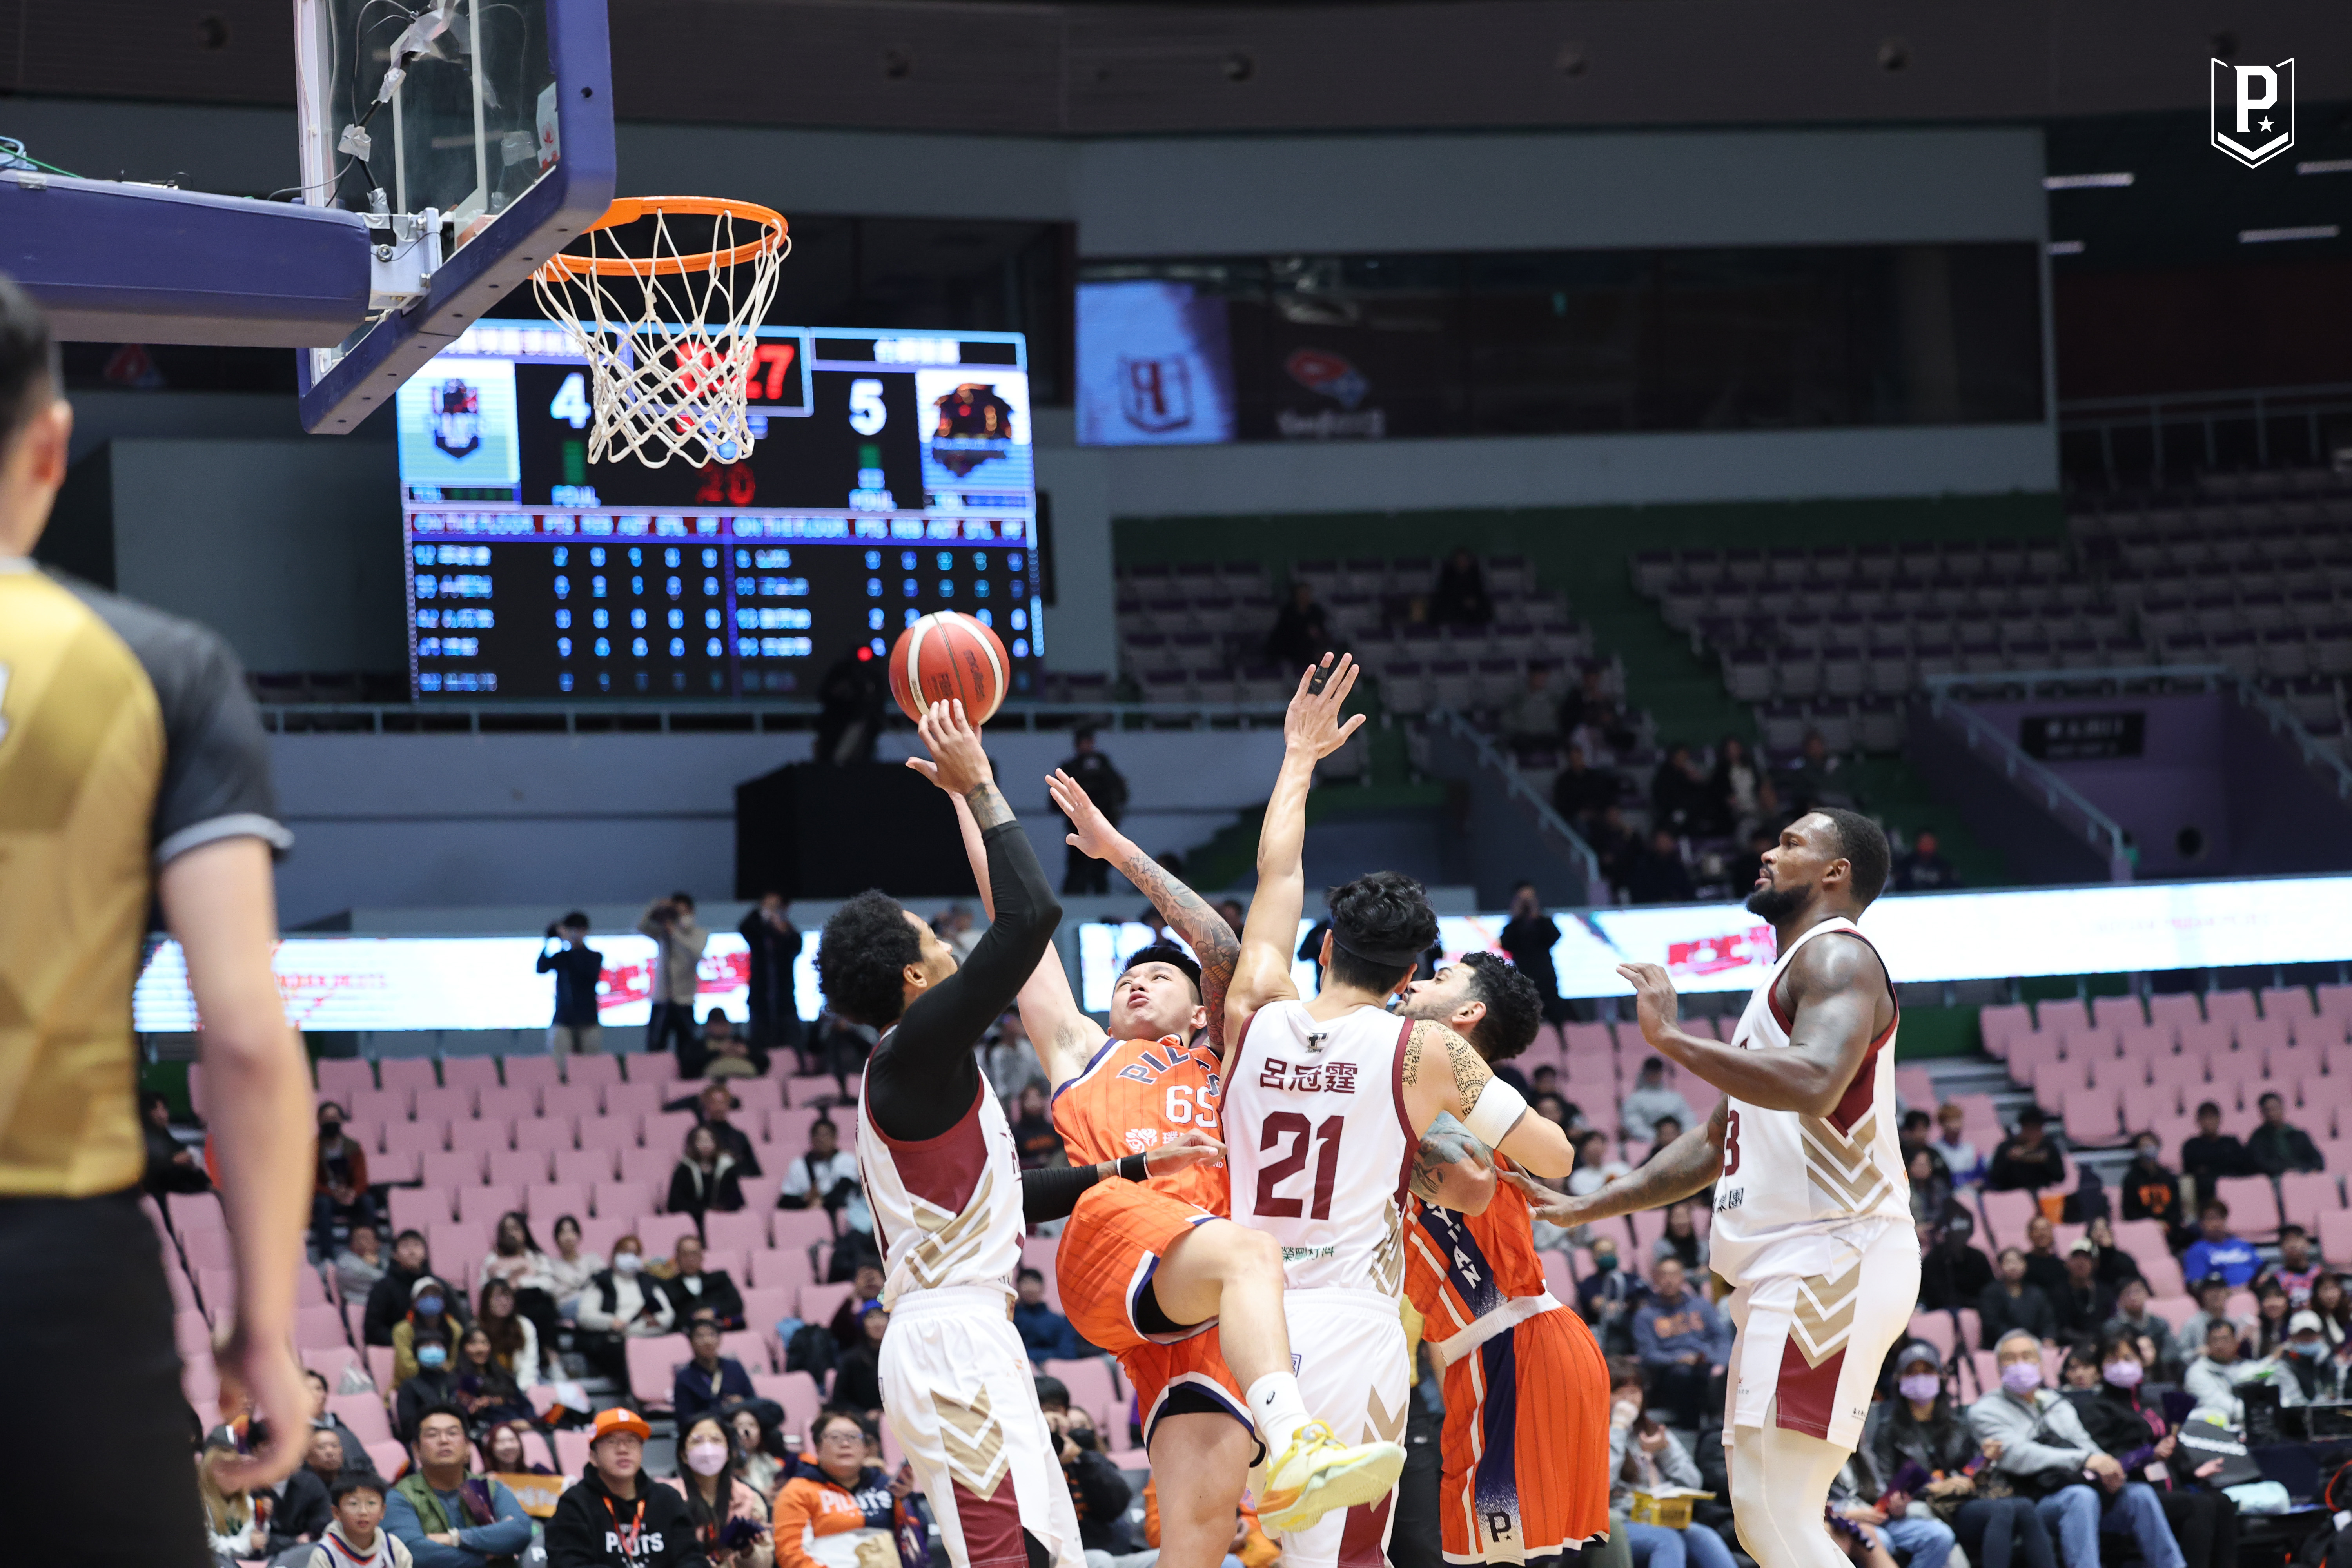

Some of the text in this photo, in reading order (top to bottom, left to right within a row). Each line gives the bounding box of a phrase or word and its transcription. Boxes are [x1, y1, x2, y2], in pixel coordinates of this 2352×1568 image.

[550, 372, 591, 429] 4
[849, 379, 887, 436] 5
[1260, 1057, 1358, 1094] 呂冠霆
[1253, 1111, 1344, 1220] 21
[1486, 1511, 1511, 1542] P
